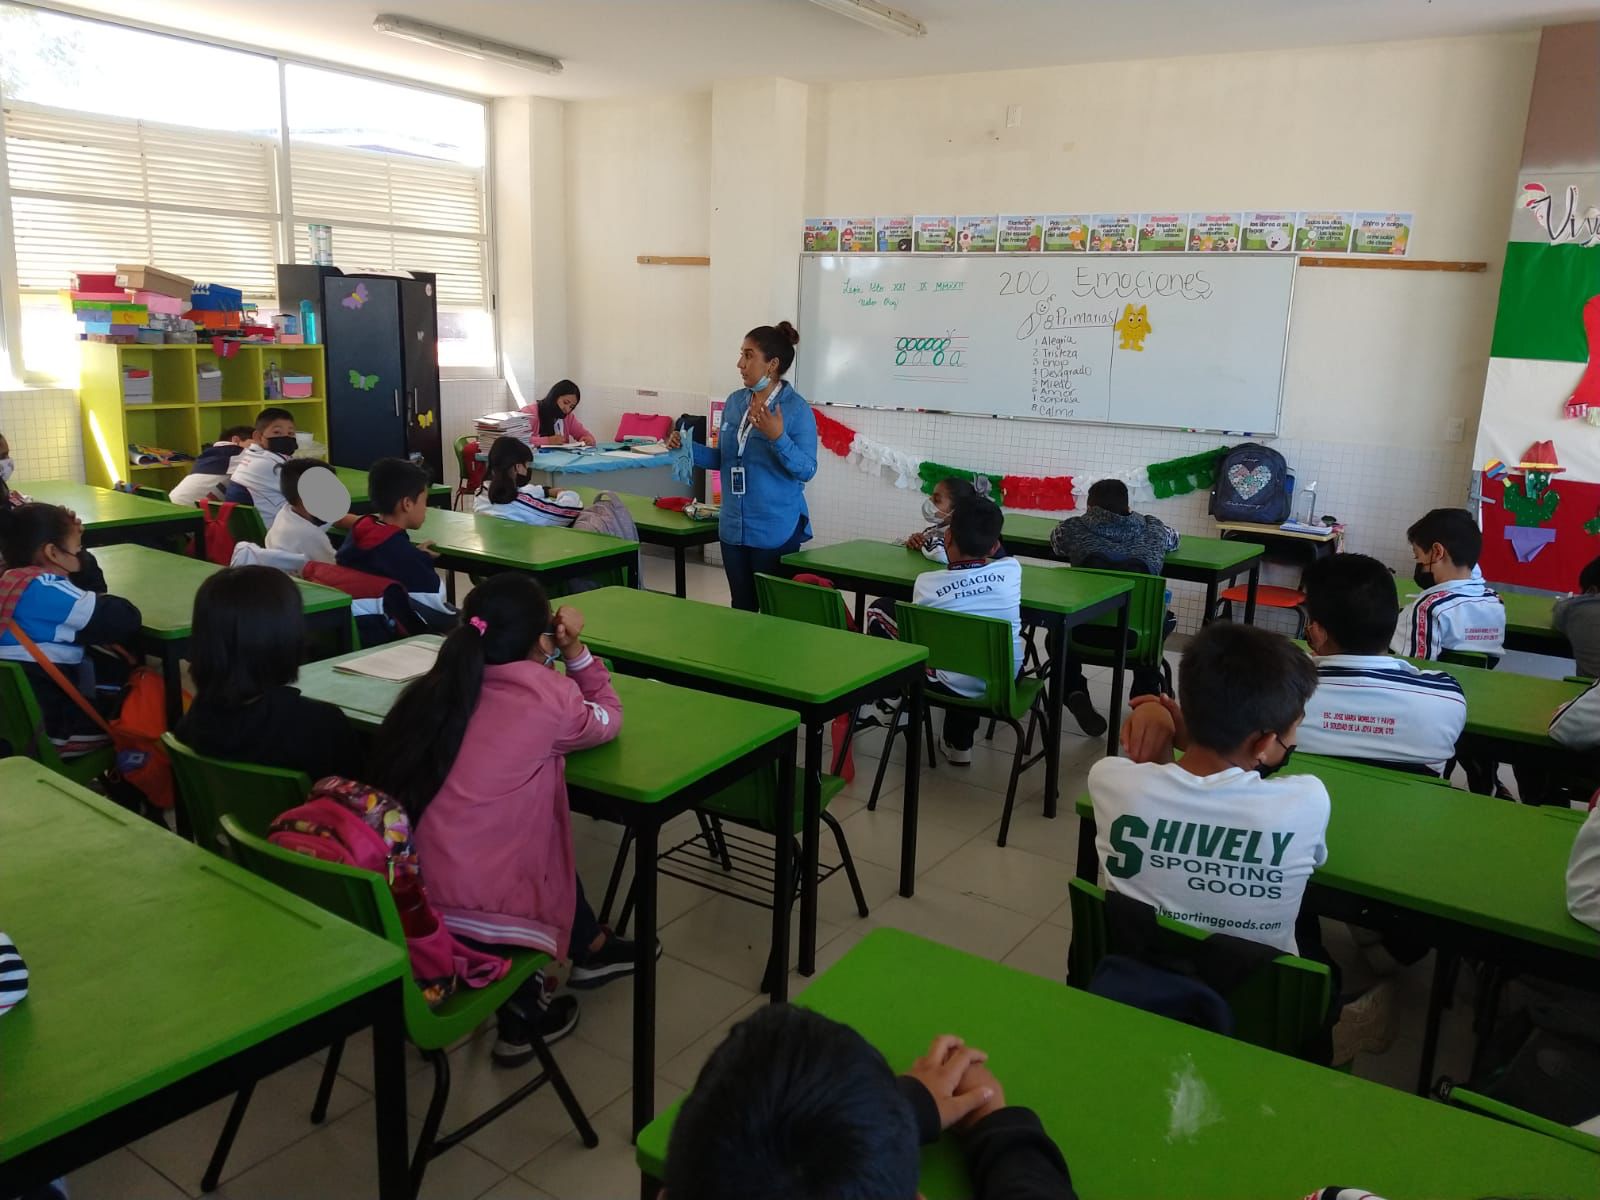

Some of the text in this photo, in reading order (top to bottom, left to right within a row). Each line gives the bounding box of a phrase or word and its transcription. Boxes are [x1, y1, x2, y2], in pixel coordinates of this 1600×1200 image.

[1000, 266, 1211, 295] 200 Emociones
[935, 573, 1005, 598] EDUCACIÓN
[954, 585, 993, 599] FÍSICA
[1106, 814, 1295, 879] SHIVELY
[1150, 854, 1284, 883] SPORTING
[1187, 876, 1282, 900] GOODS
[1156, 905, 1281, 930] lysportinggoods.com
